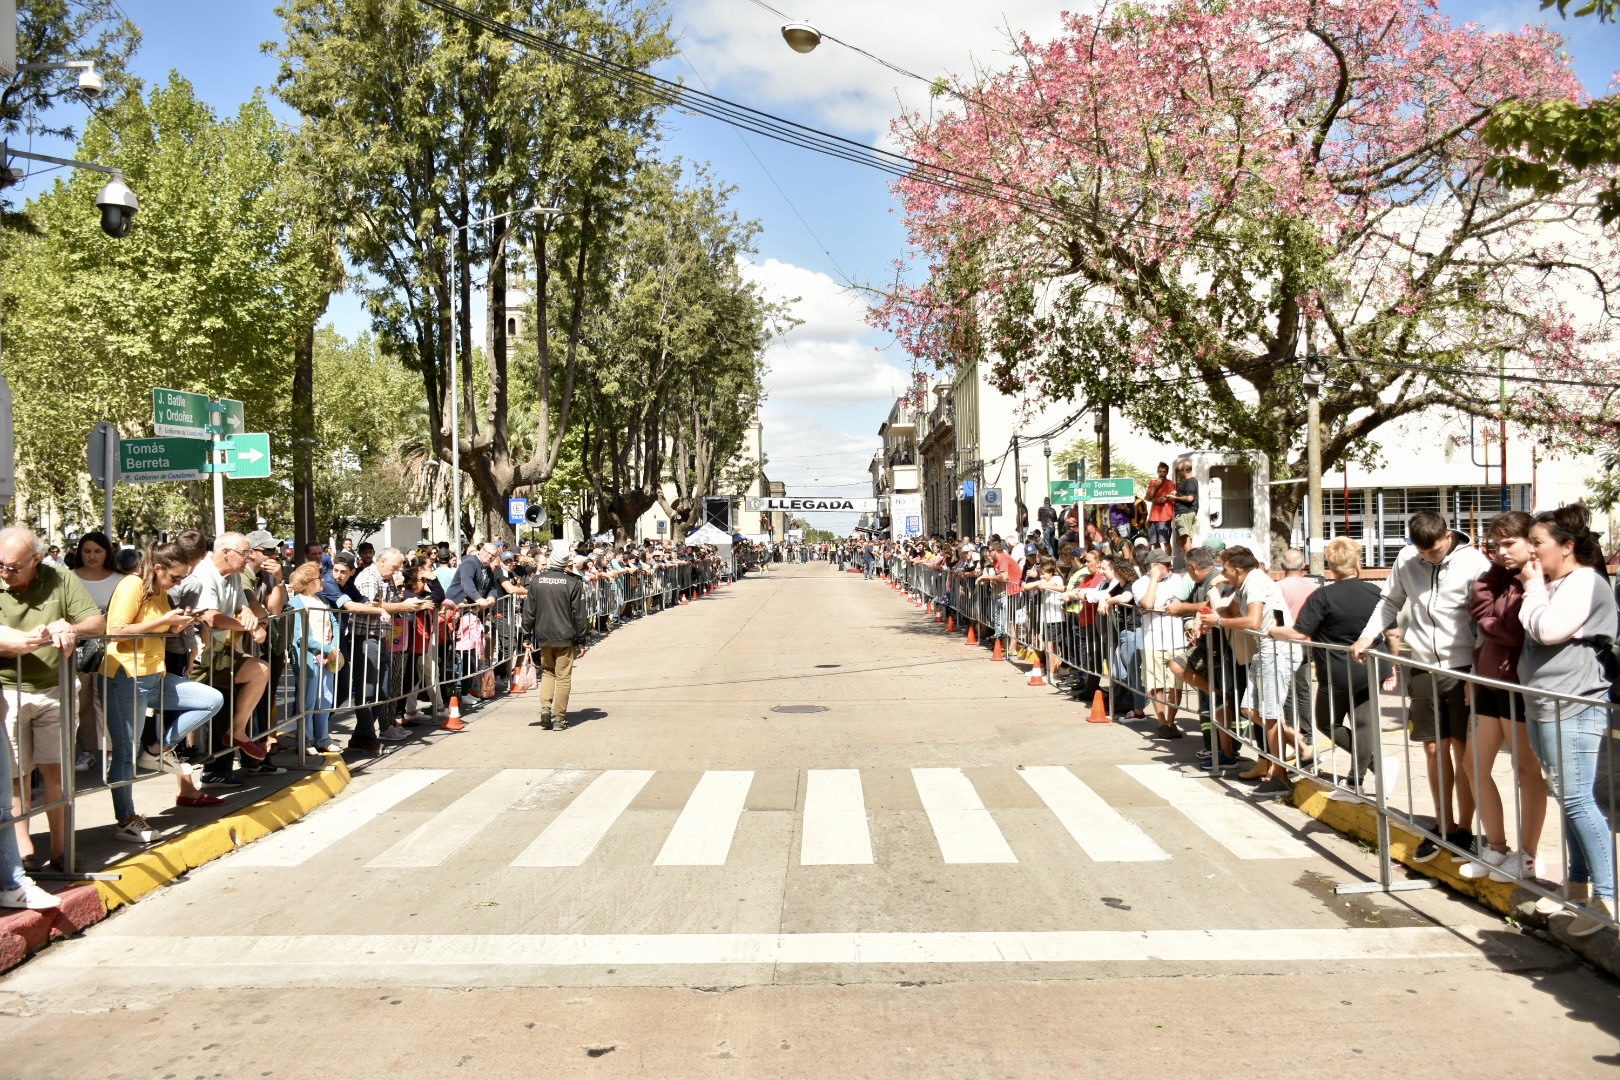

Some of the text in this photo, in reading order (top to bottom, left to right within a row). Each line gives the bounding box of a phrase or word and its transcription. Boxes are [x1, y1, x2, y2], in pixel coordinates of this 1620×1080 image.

[158, 393, 186, 407] J. Batlle
[159, 409, 194, 424] y Ordoñez
[126, 442, 165, 455] Tomás
[126, 458, 170, 470] Berreta
[1093, 481, 1116, 489] Tomás
[987, 492, 994, 502] E
[1093, 489, 1119, 497] Berreta
[768, 500, 854, 509] LLEGADA
[538, 577, 567, 585] Kappa
